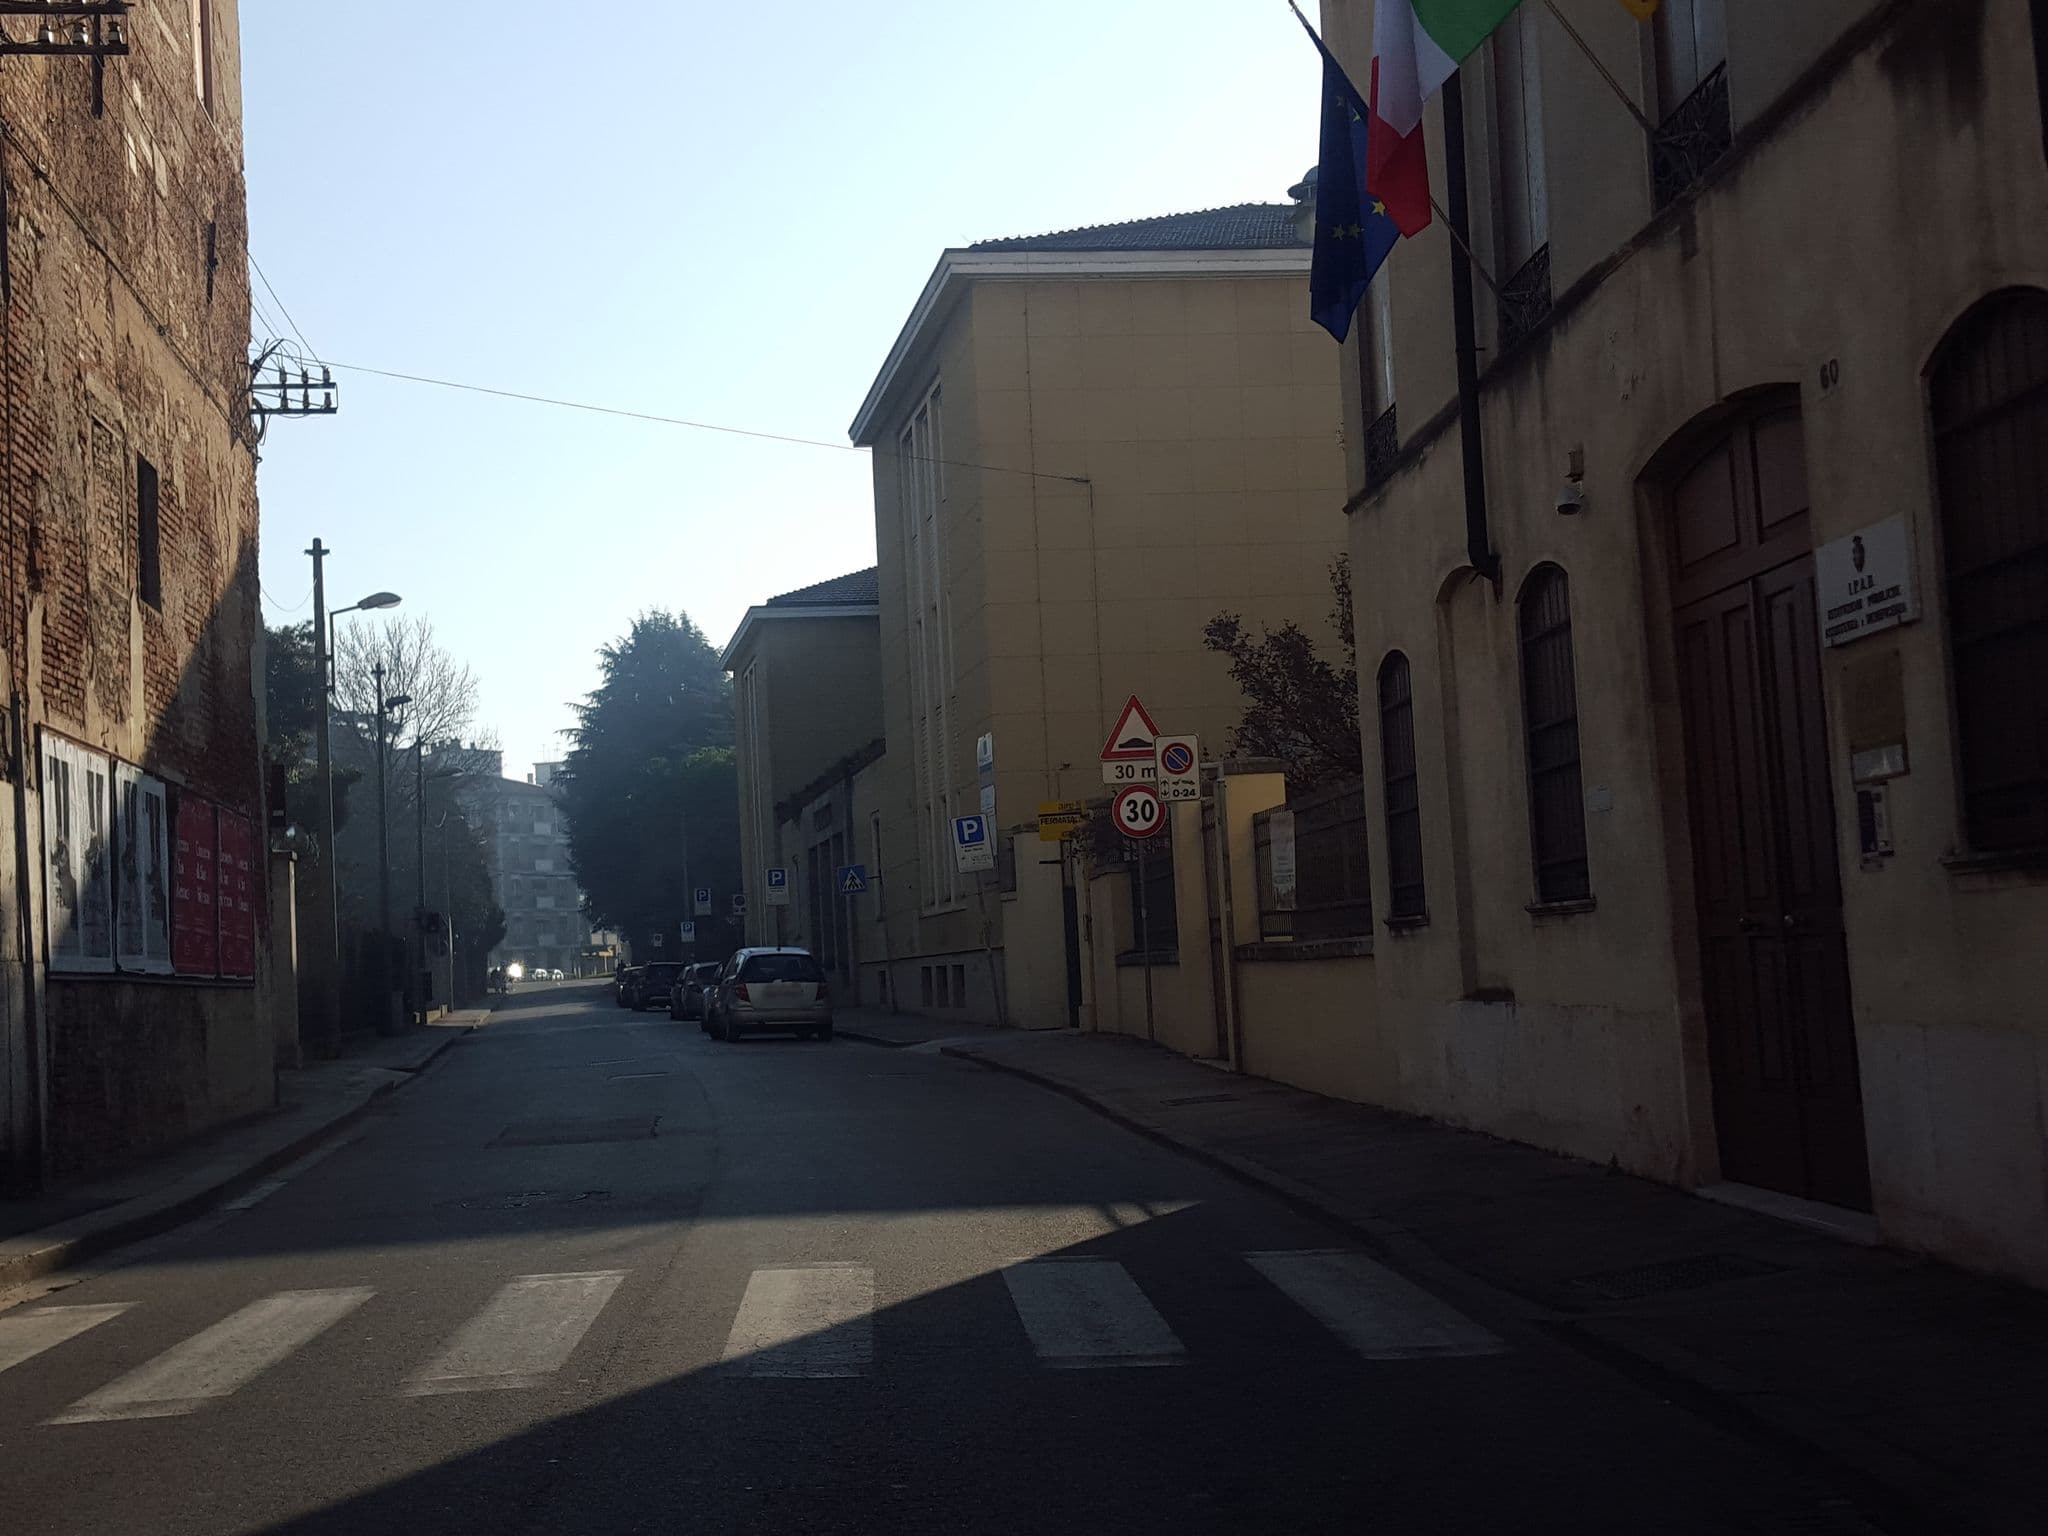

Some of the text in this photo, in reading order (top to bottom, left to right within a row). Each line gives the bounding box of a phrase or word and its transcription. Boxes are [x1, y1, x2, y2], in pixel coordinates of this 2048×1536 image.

[1115, 765, 1156, 779] 30 m
[1173, 789, 1196, 797] 0-24
[1126, 799, 1154, 822] 30
[961, 819, 978, 841] P
[771, 871, 783, 885] P
[698, 890, 706, 901] P
